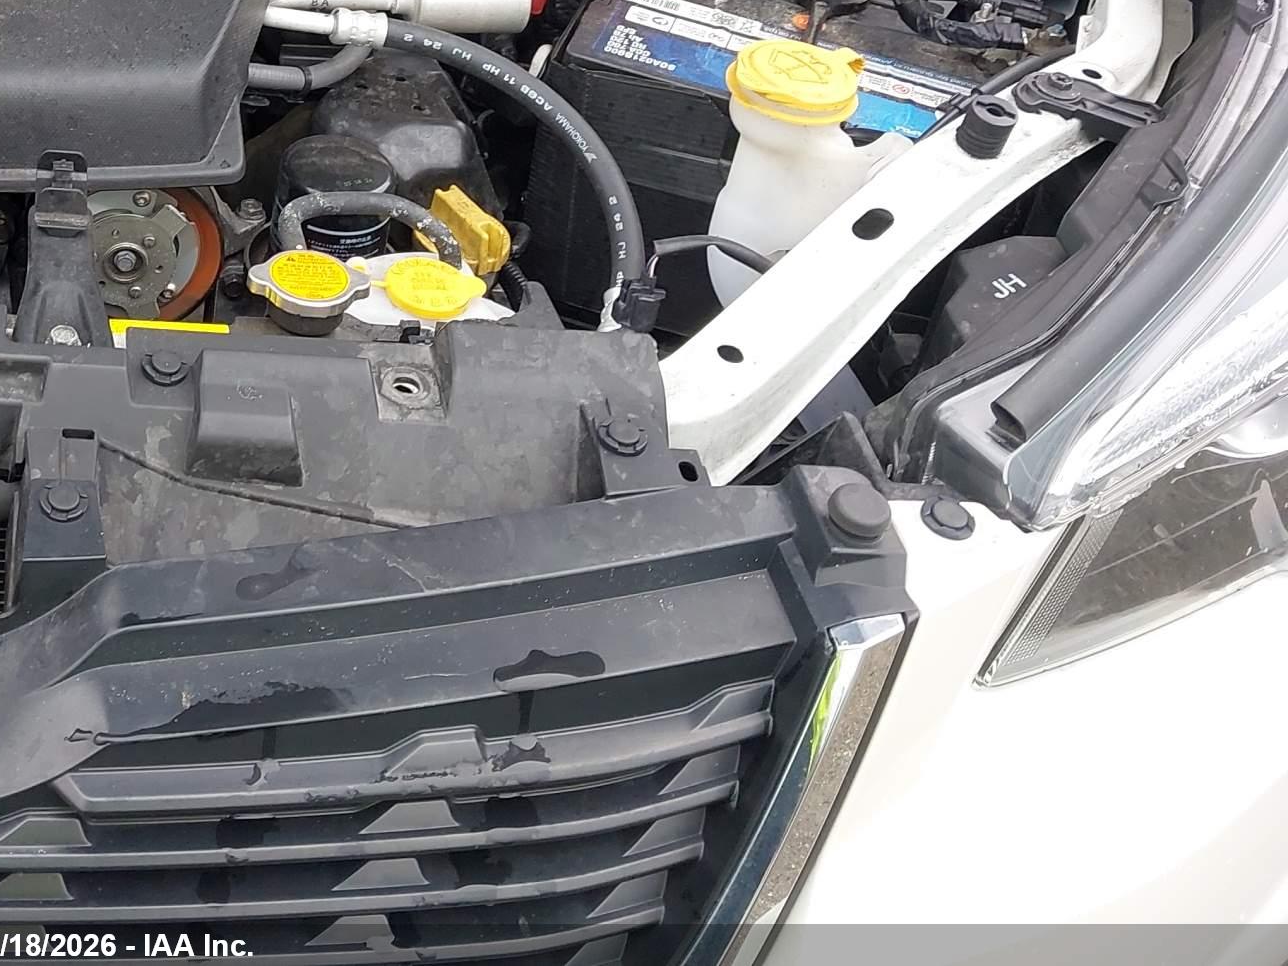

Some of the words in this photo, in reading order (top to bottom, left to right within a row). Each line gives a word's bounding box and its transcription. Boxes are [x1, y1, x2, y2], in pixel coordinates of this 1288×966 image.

[403, 33, 414, 42] 2
[423, 38, 443, 51] 24
[452, 47, 472, 61] HJ
[482, 63, 501, 76] HP
[554, 112, 590, 153] YOKOHAMA
[992, 273, 1028, 300] JH
